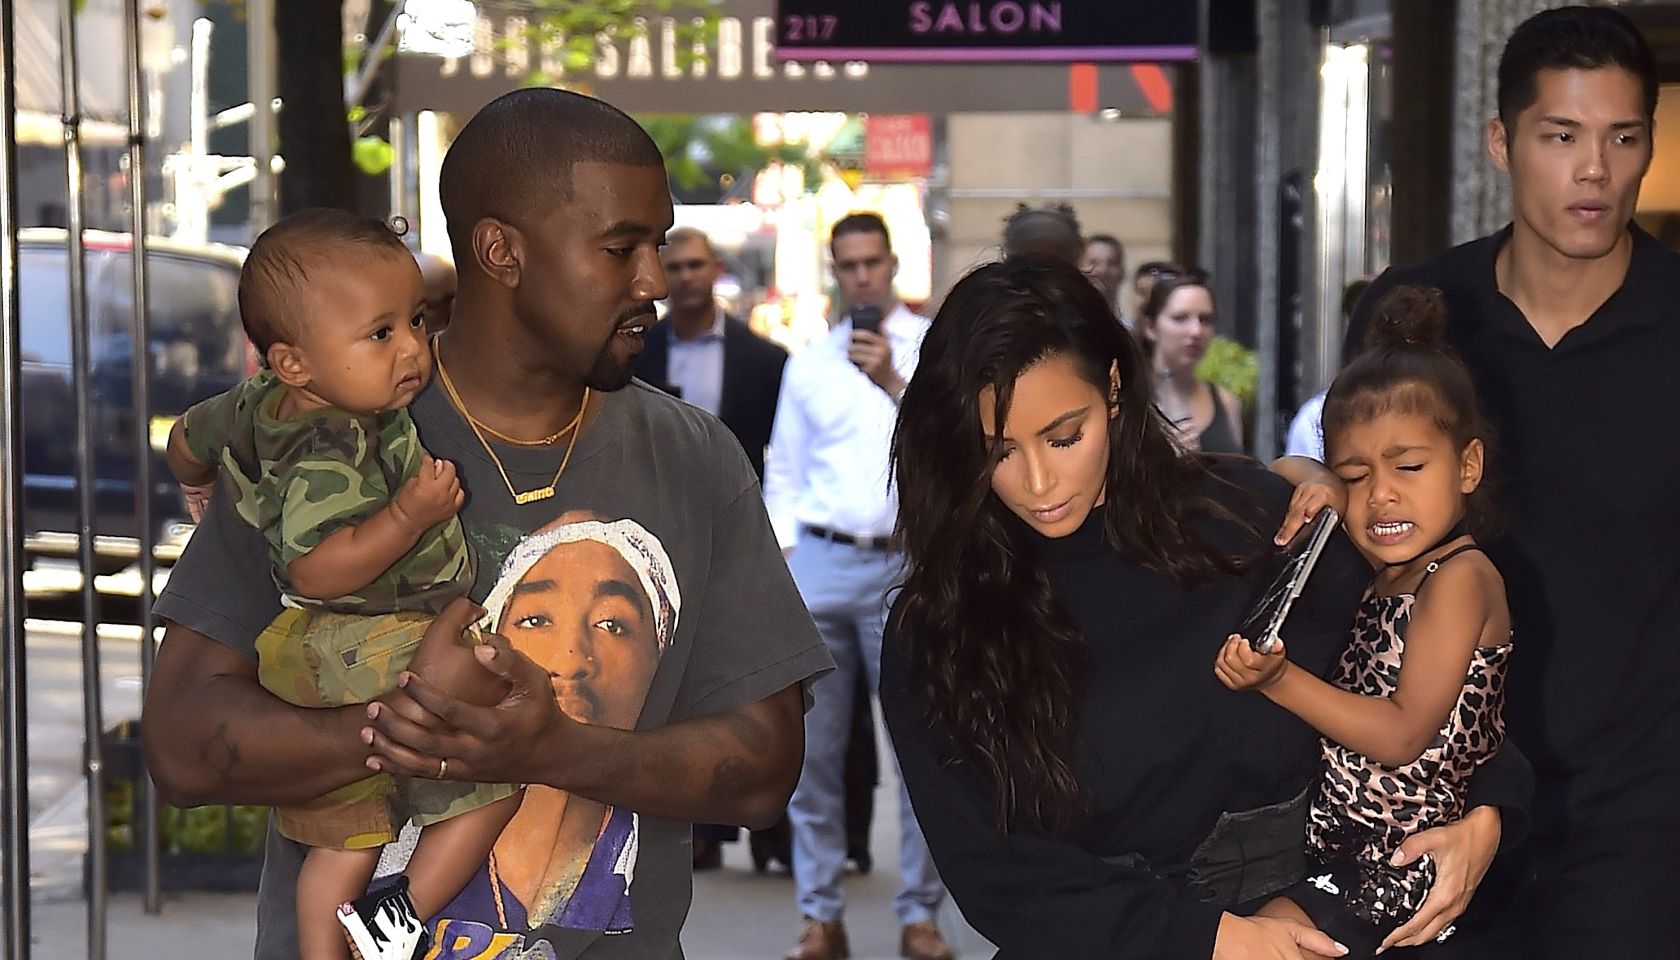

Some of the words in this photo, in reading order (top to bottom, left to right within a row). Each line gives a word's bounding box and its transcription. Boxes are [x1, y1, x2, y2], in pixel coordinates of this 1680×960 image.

[785, 14, 838, 41] 217
[910, 1, 1062, 33] SALON
[594, 16, 870, 79] SALIBE
